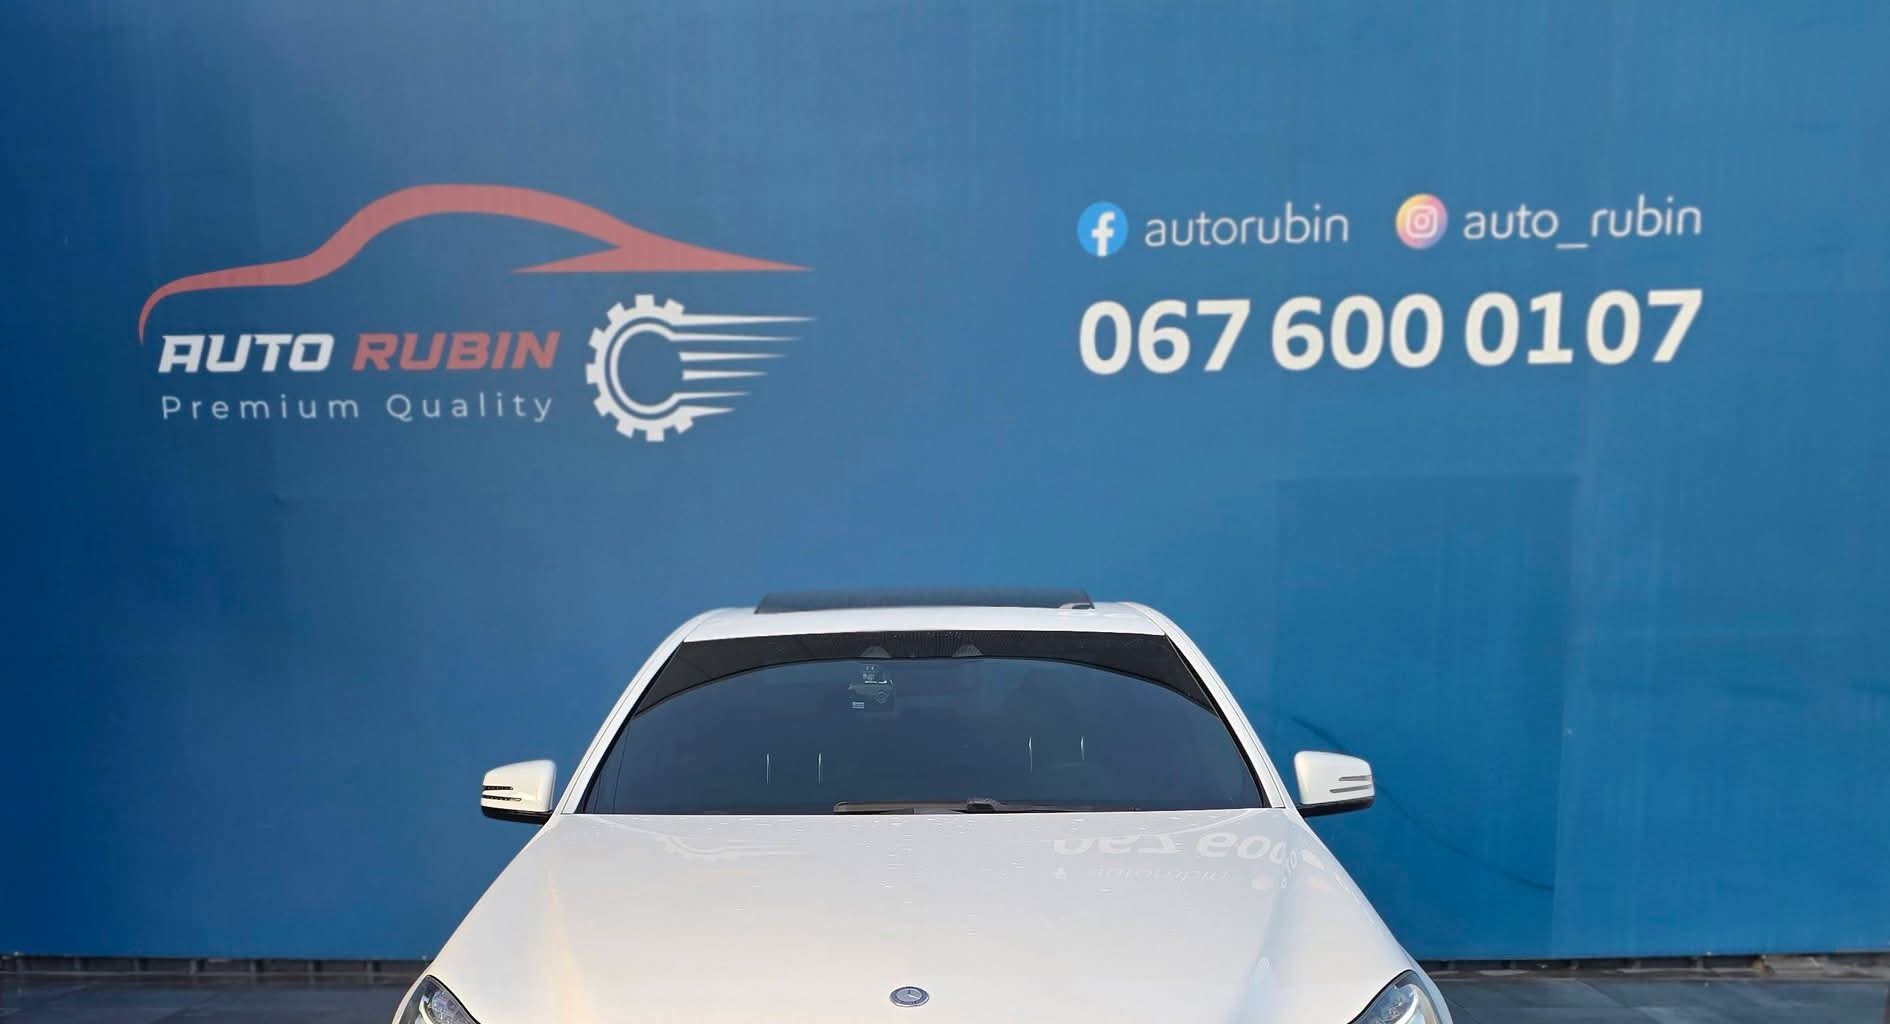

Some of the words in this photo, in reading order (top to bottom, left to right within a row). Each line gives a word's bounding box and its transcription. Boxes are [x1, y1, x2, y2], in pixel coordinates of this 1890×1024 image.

[1144, 202, 1350, 248] autorubin
[1463, 195, 1703, 250] auto_rubin
[157, 333, 335, 373] AUTO
[352, 330, 562, 372] RUBIN
[1079, 299, 1251, 375] 067
[1270, 294, 1445, 371] 600
[1464, 289, 1704, 367] 0107
[161, 394, 359, 421] Premium
[385, 392, 553, 423] Quality
